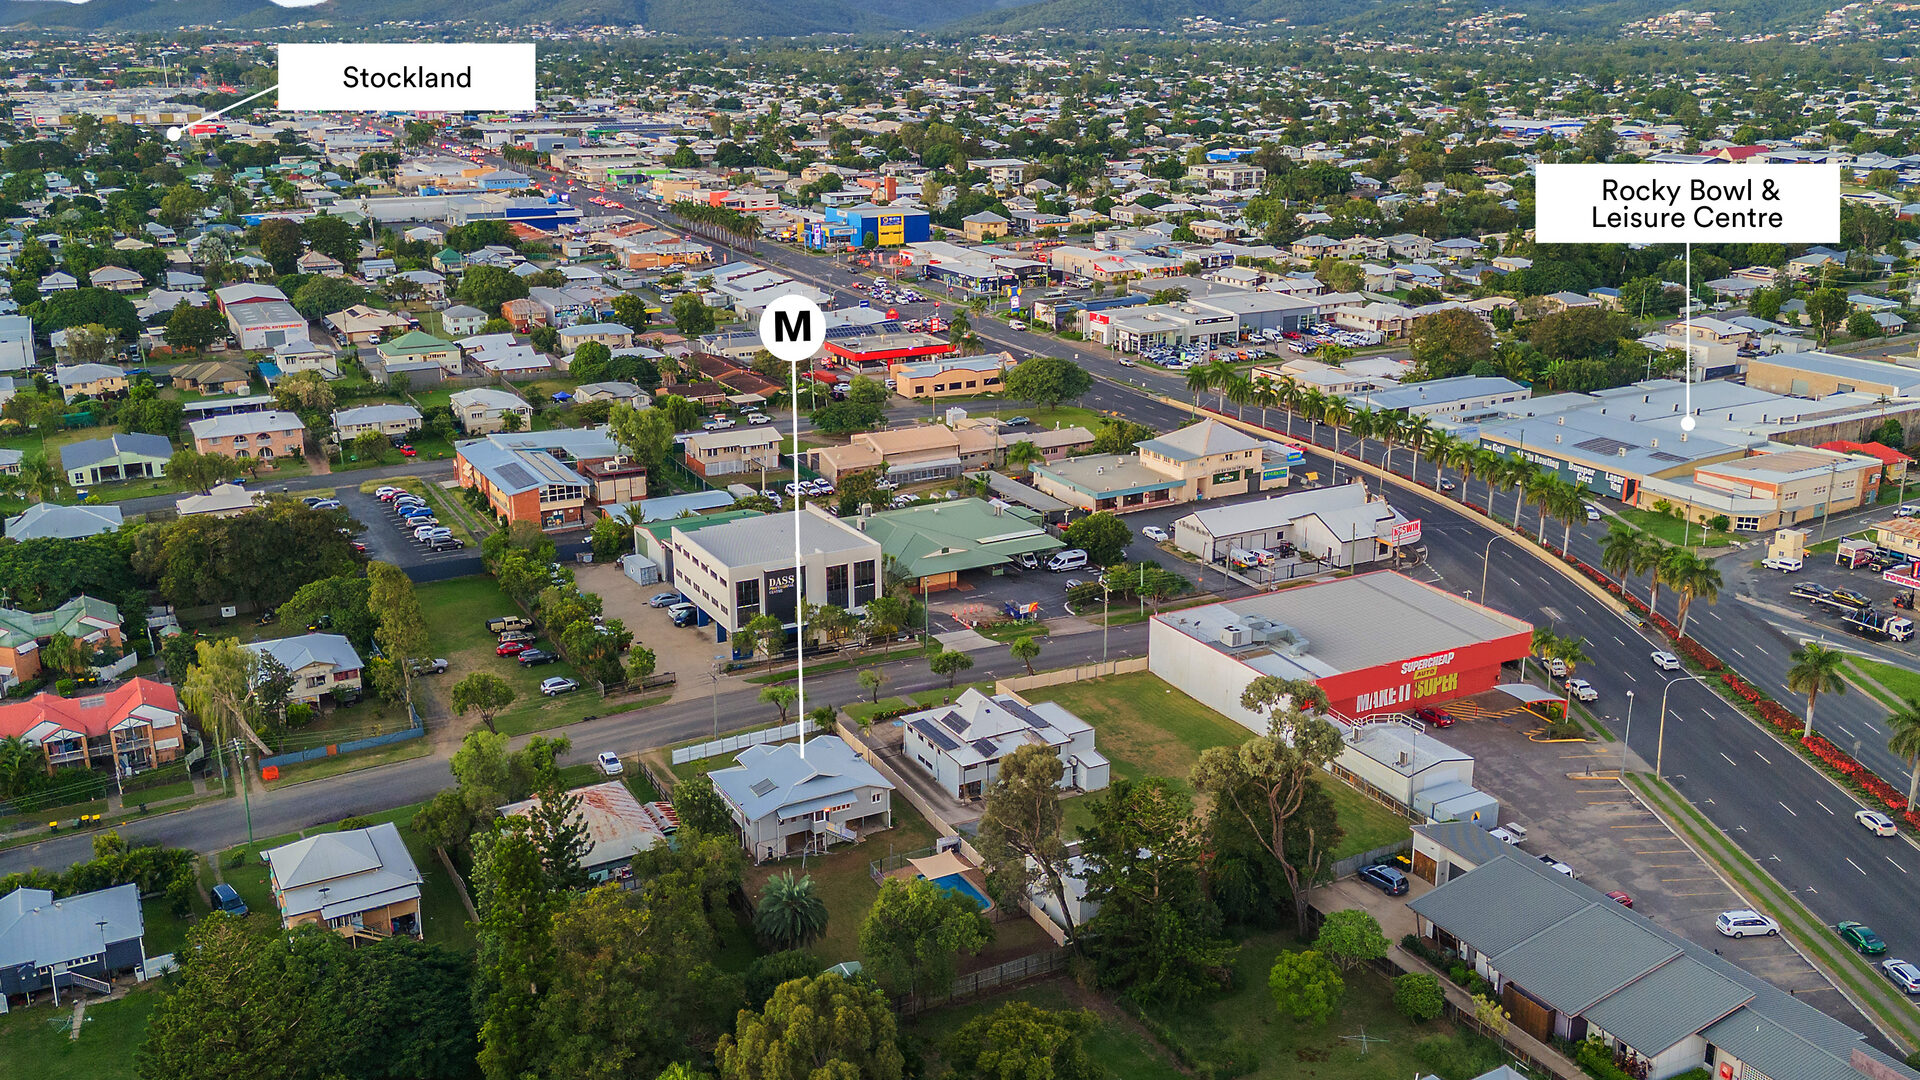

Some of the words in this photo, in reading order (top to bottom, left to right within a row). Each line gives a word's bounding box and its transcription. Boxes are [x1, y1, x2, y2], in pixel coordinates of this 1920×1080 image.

[1492, 443, 1506, 455] Golf
[1534, 454, 1560, 470] Bowling
[1568, 461, 1596, 477] Bumper
[1576, 472, 1593, 485] Cars
[1605, 471, 1626, 485] Laser
[1609, 481, 1622, 494] Tag
[769, 575, 795, 587] DASS
[1885, 573, 1920, 587] TOWING
[1401, 652, 1455, 674] SUPERCHEAP
[1416, 668, 1435, 678] AUTO
[1356, 688, 1397, 712] MAKE
[1414, 673, 1458, 698] SUPER
